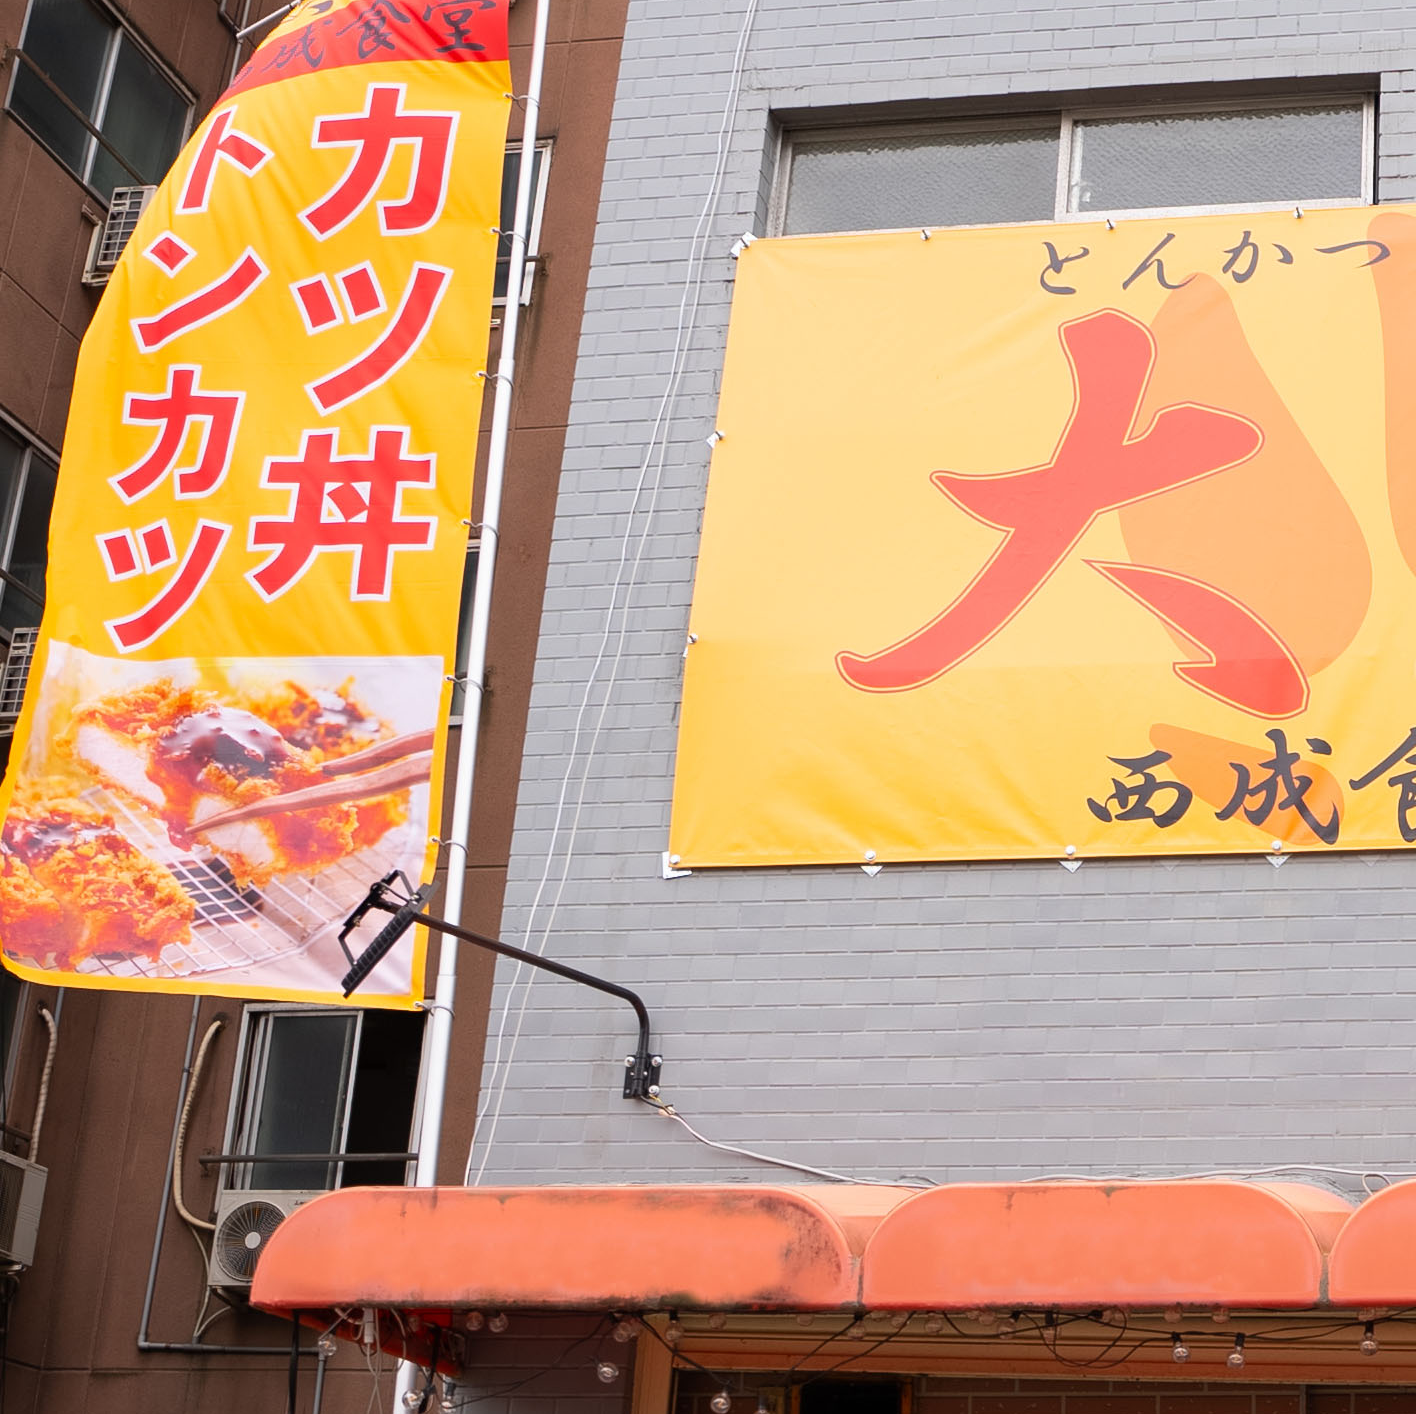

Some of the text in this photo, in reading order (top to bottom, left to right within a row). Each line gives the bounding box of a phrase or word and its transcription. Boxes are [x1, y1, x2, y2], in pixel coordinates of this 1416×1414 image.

[97, 104, 272, 653] トンカツ
[246, 81, 463, 602] カツ丼
